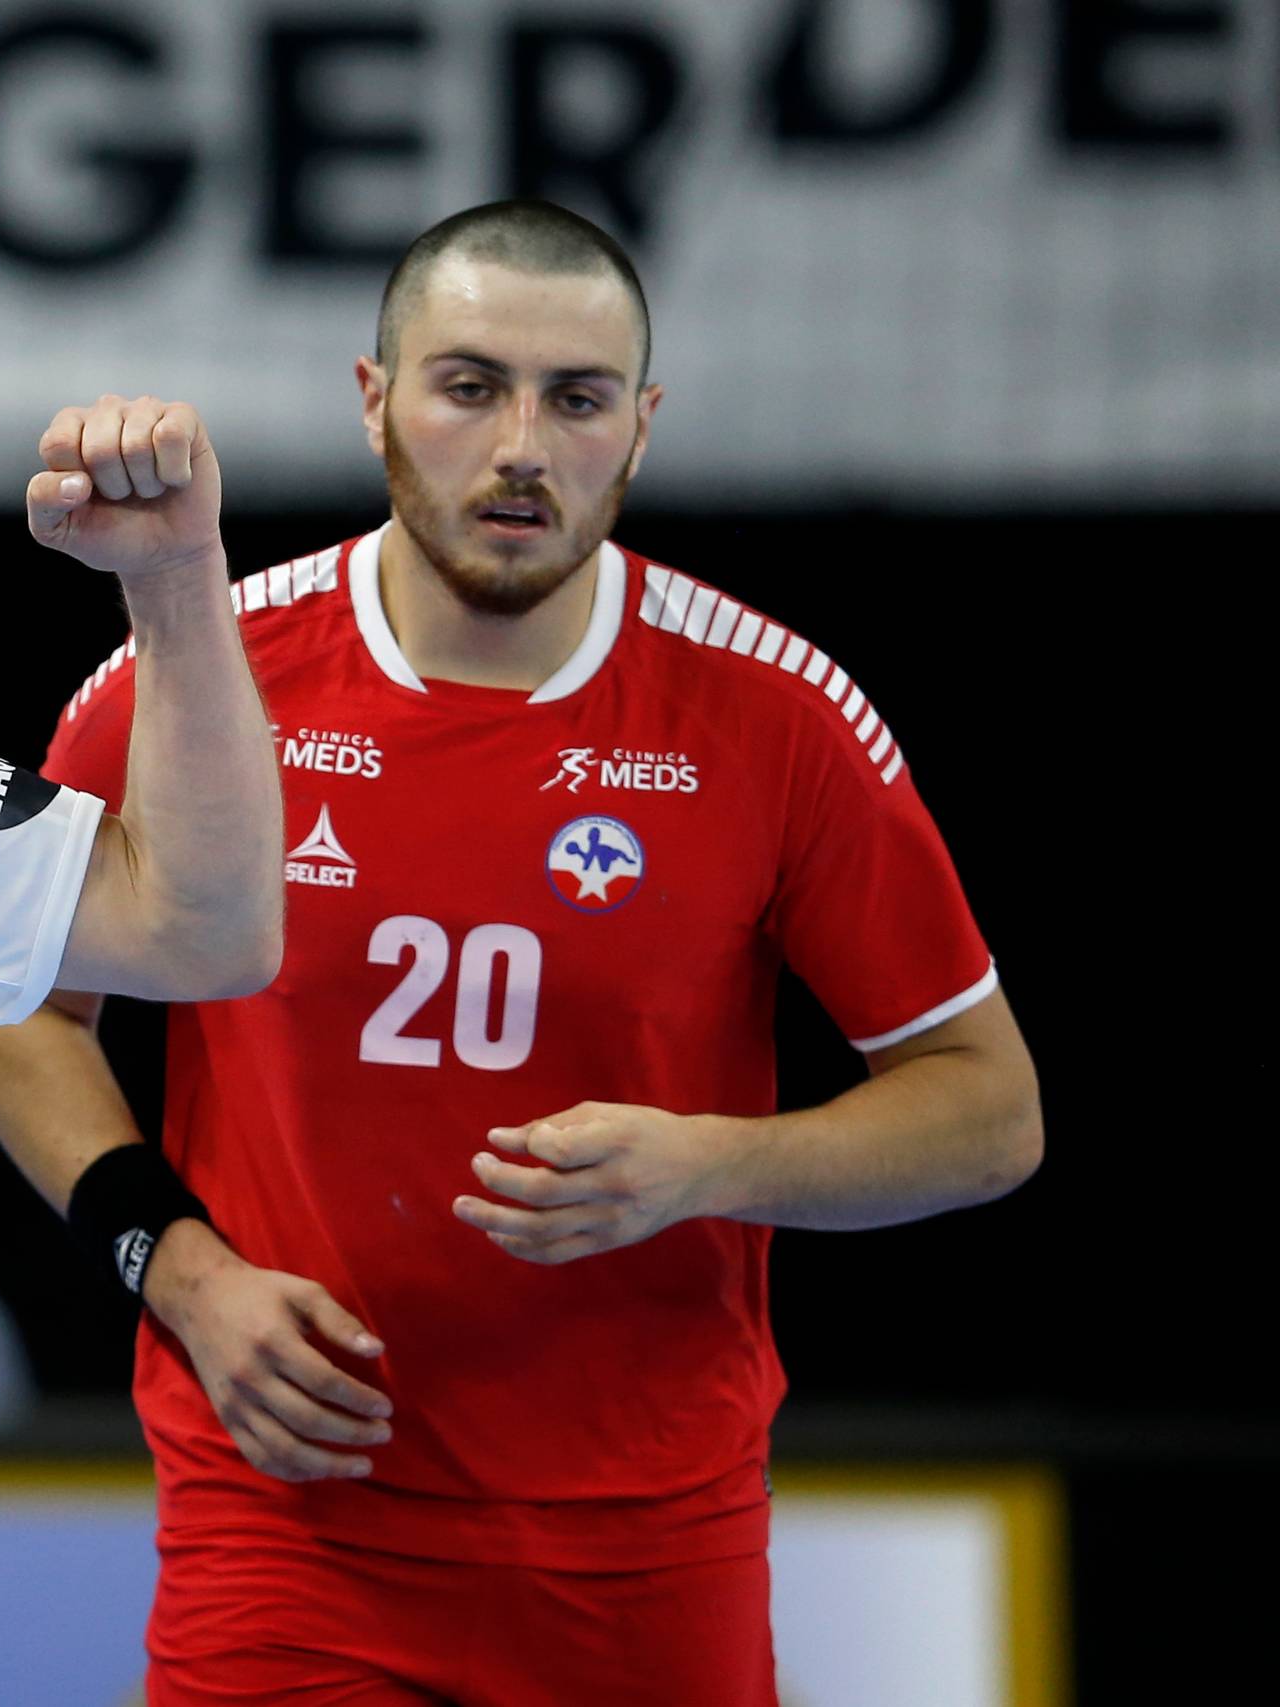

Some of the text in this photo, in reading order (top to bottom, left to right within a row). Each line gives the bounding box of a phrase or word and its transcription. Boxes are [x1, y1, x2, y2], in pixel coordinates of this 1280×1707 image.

[766, 0, 1280, 148] DE
[297, 727, 376, 748] CLINICA
[282, 738, 383, 779] MEDS
[612, 748, 688, 764] CLINICA
[600, 760, 699, 793] MEDS
[284, 861, 358, 888] SELECT
[358, 914, 543, 1071] 20
